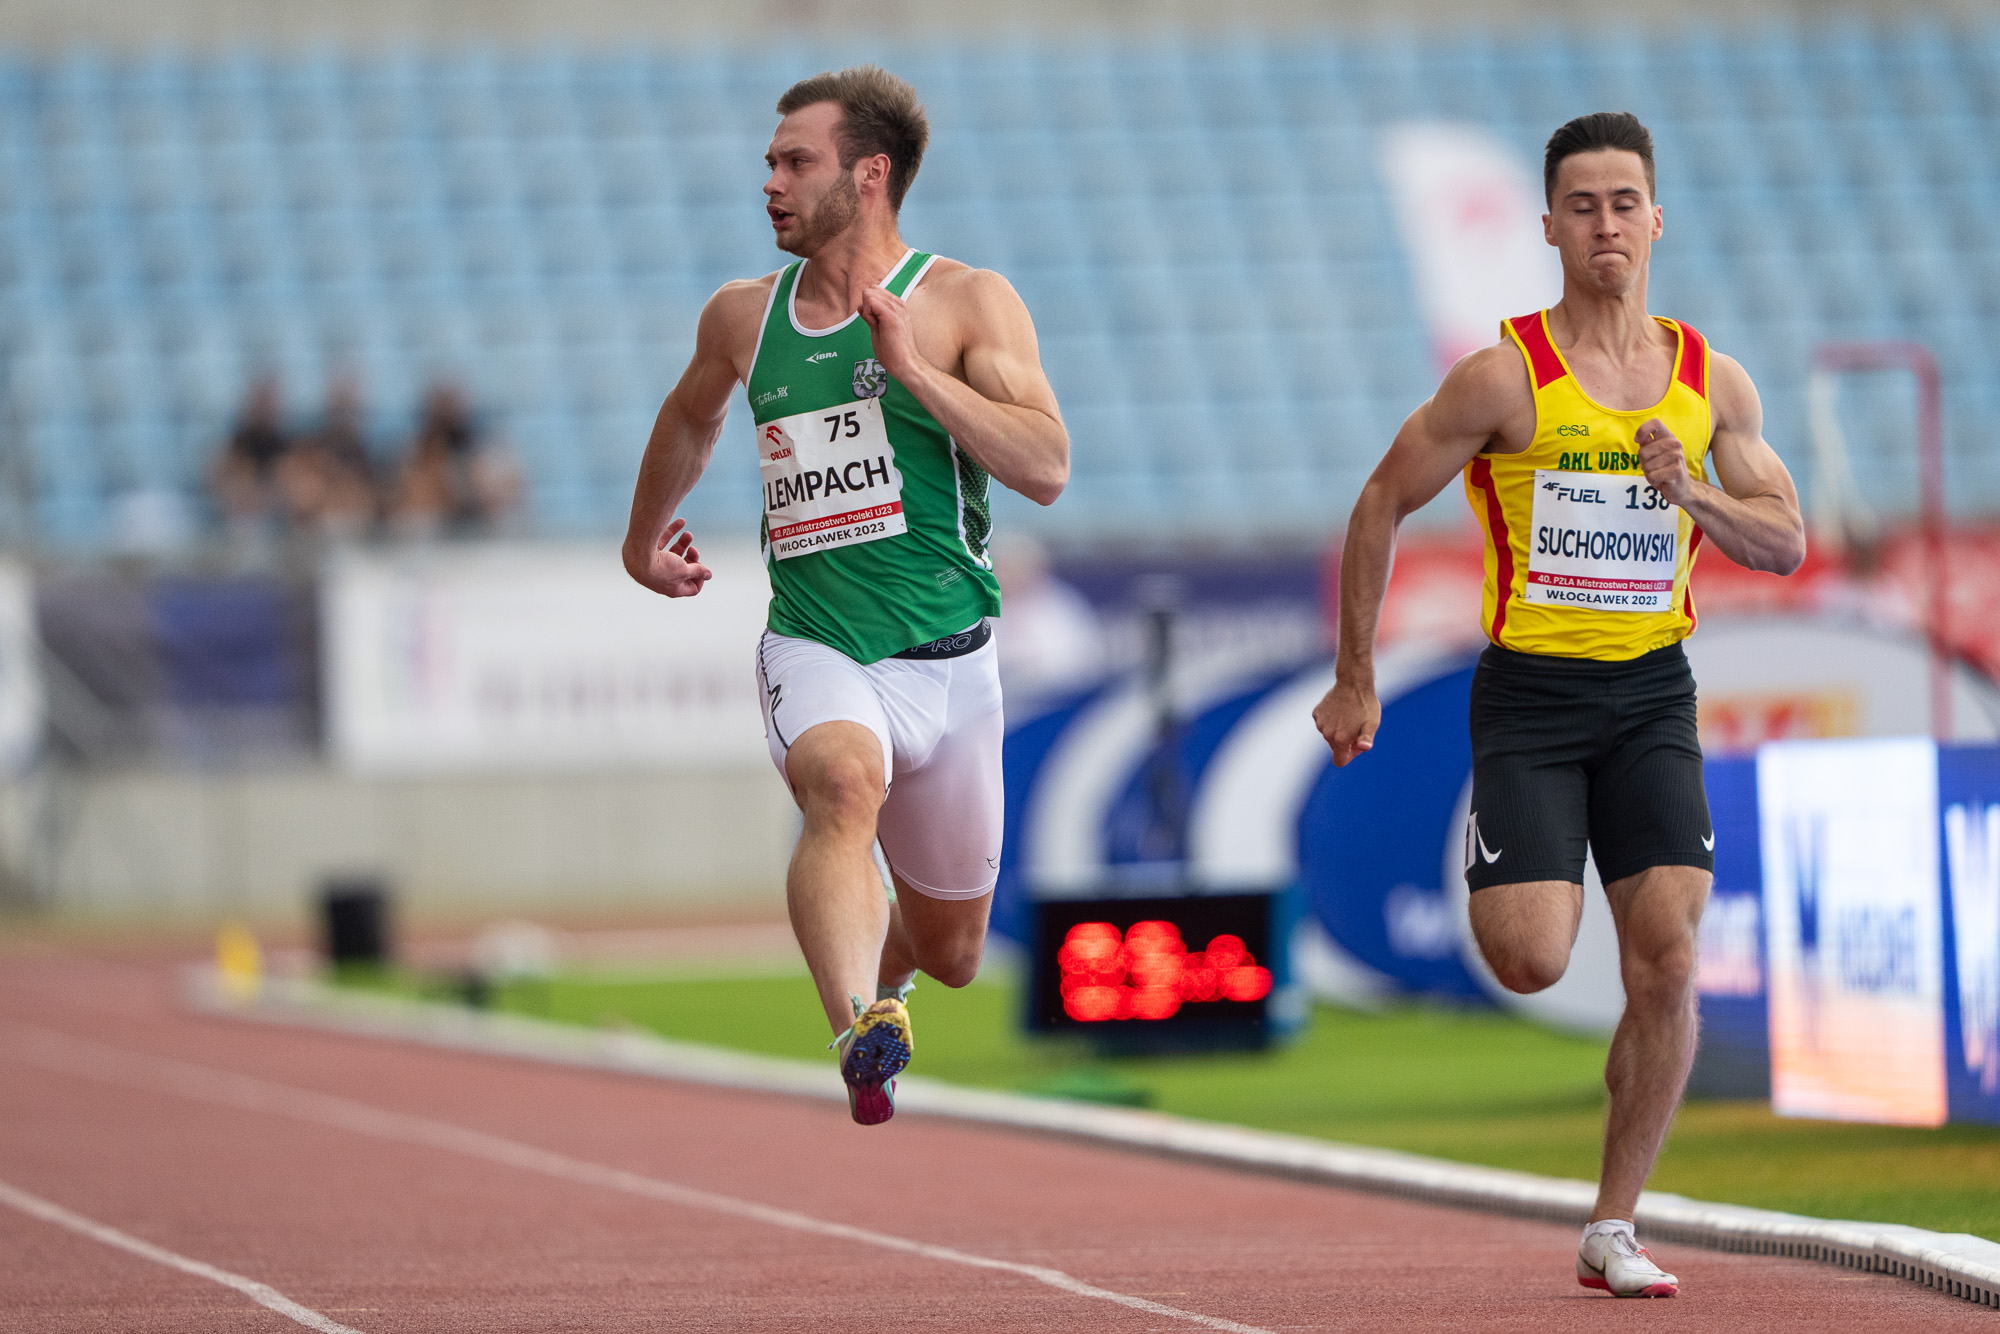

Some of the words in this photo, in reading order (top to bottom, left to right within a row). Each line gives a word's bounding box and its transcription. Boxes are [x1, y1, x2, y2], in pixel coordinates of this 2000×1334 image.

[824, 411, 861, 442] 75
[1557, 424, 1590, 437] esa
[770, 448, 792, 461] ORLEN
[1558, 451, 1592, 470] AKL
[1598, 451, 1640, 470] URSY
[767, 456, 890, 511] LEMPACH
[1557, 487, 1606, 504] FUEL
[782, 525, 796, 537] PZLA
[796, 516, 846, 533] Mistrzostwa
[847, 508, 873, 523] Polski
[875, 505, 893, 517] U23
[779, 528, 851, 553] WŁOCŁAWEK
[854, 521, 886, 537] 2023
[1537, 526, 1674, 562] SUCHOROWSKI
[1537, 574, 1552, 584] 40.
[1553, 576, 1575, 586] PZLA
[1576, 579, 1628, 589] Mistrzostwa
[1629, 581, 1653, 590] Polski
[1653, 581, 1666, 590] U23
[1546, 589, 1629, 605] WŁOCŁAWEK
[1631, 595, 1658, 606] 2023
